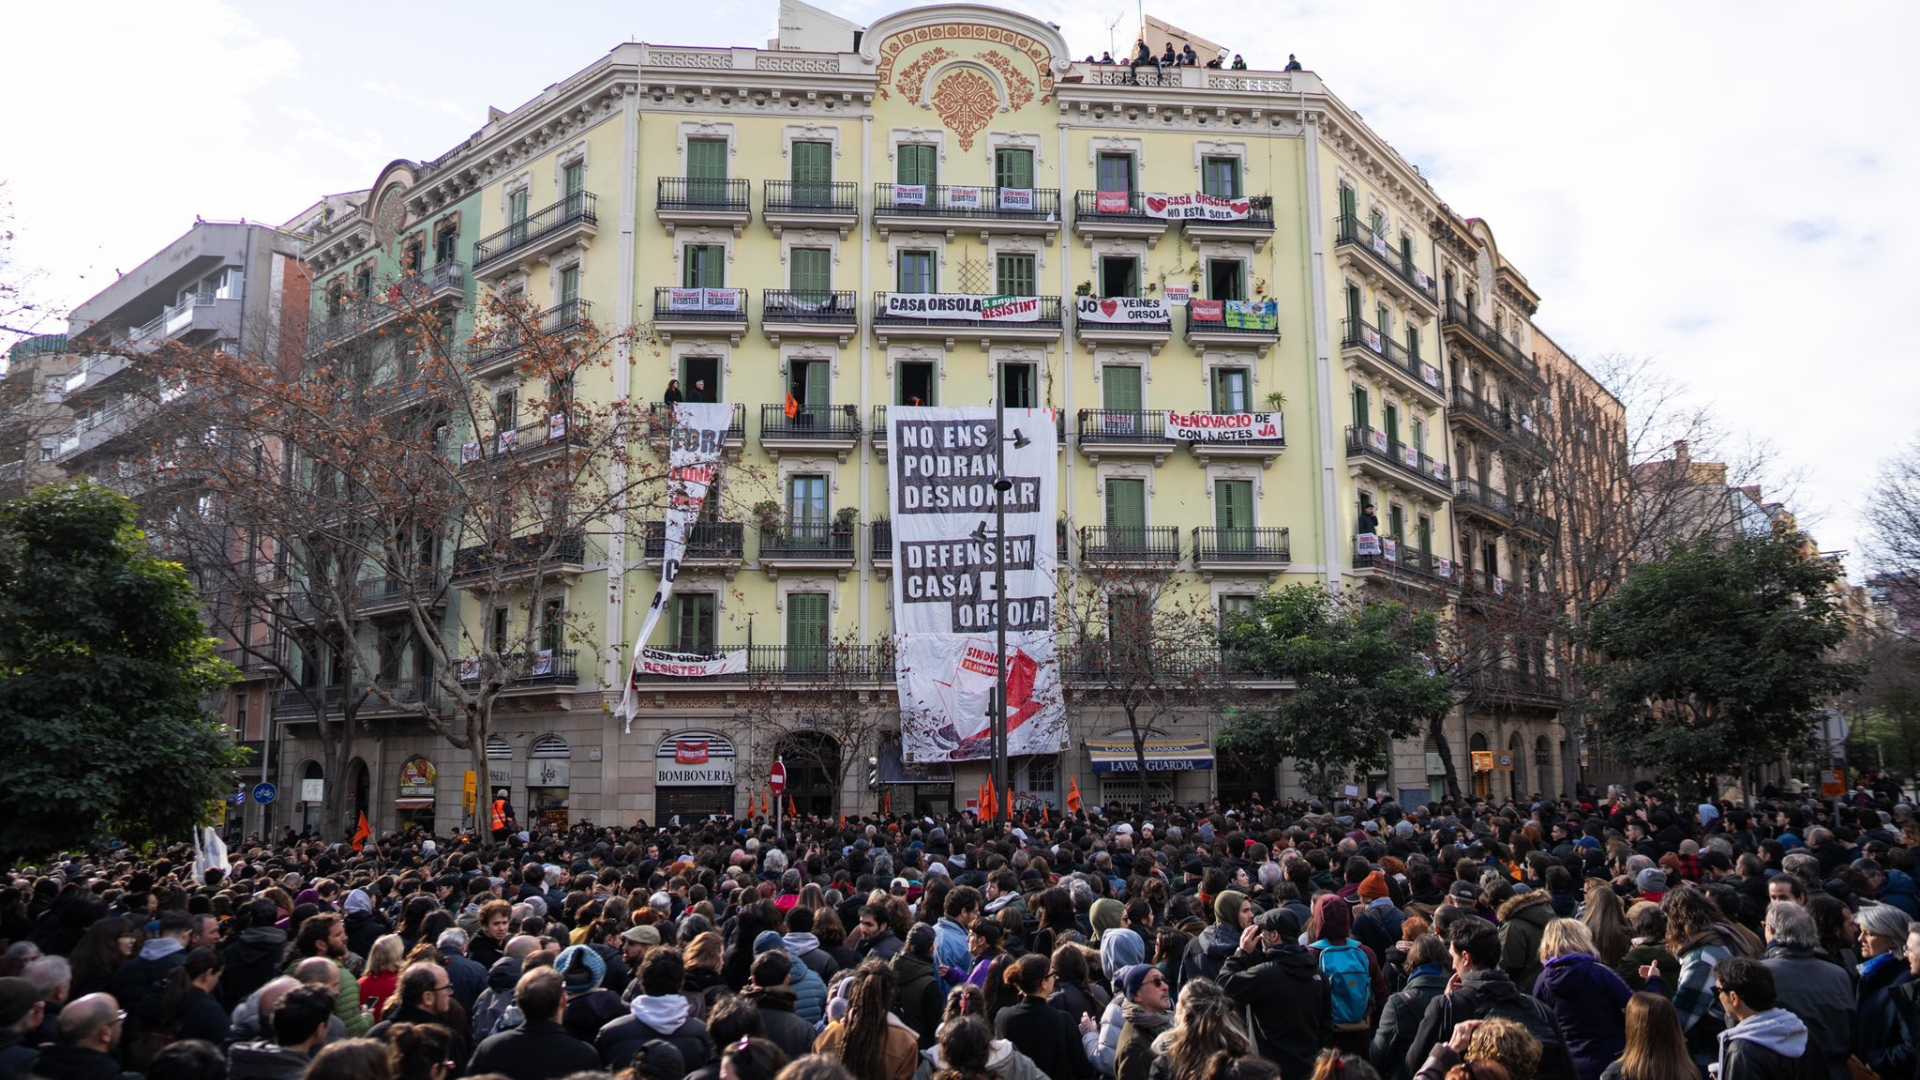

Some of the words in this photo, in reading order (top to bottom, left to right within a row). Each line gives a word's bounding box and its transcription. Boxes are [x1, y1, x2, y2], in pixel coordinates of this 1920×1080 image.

[1168, 197, 1192, 206] CASA
[1196, 194, 1231, 207] ORSOLA
[1168, 208, 1180, 218] NO
[1209, 210, 1232, 219] SOLA
[890, 298, 926, 312] CASA
[928, 298, 982, 312] ORSOLA
[983, 300, 990, 308] 2
[992, 296, 1017, 308] anys
[1078, 299, 1098, 313] JO
[982, 299, 1038, 320] RESISTINT
[1128, 309, 1170, 320] ORSOLA
[1254, 414, 1270, 424] DE
[903, 426, 934, 448] NO
[944, 424, 988, 448] ENS
[1258, 424, 1277, 437] JA
[904, 454, 998, 477] PODRAN
[908, 540, 1032, 568] DEFENSEM
[908, 574, 973, 598] CASA
[643, 649, 673, 662] CASA
[678, 652, 727, 662] ORSOLA
[644, 662, 707, 675] RESISTEIX
[1110, 762, 1124, 772] LA
[1124, 760, 1195, 771] VAGUARDIA
[658, 770, 733, 784] BOMBONERIA
